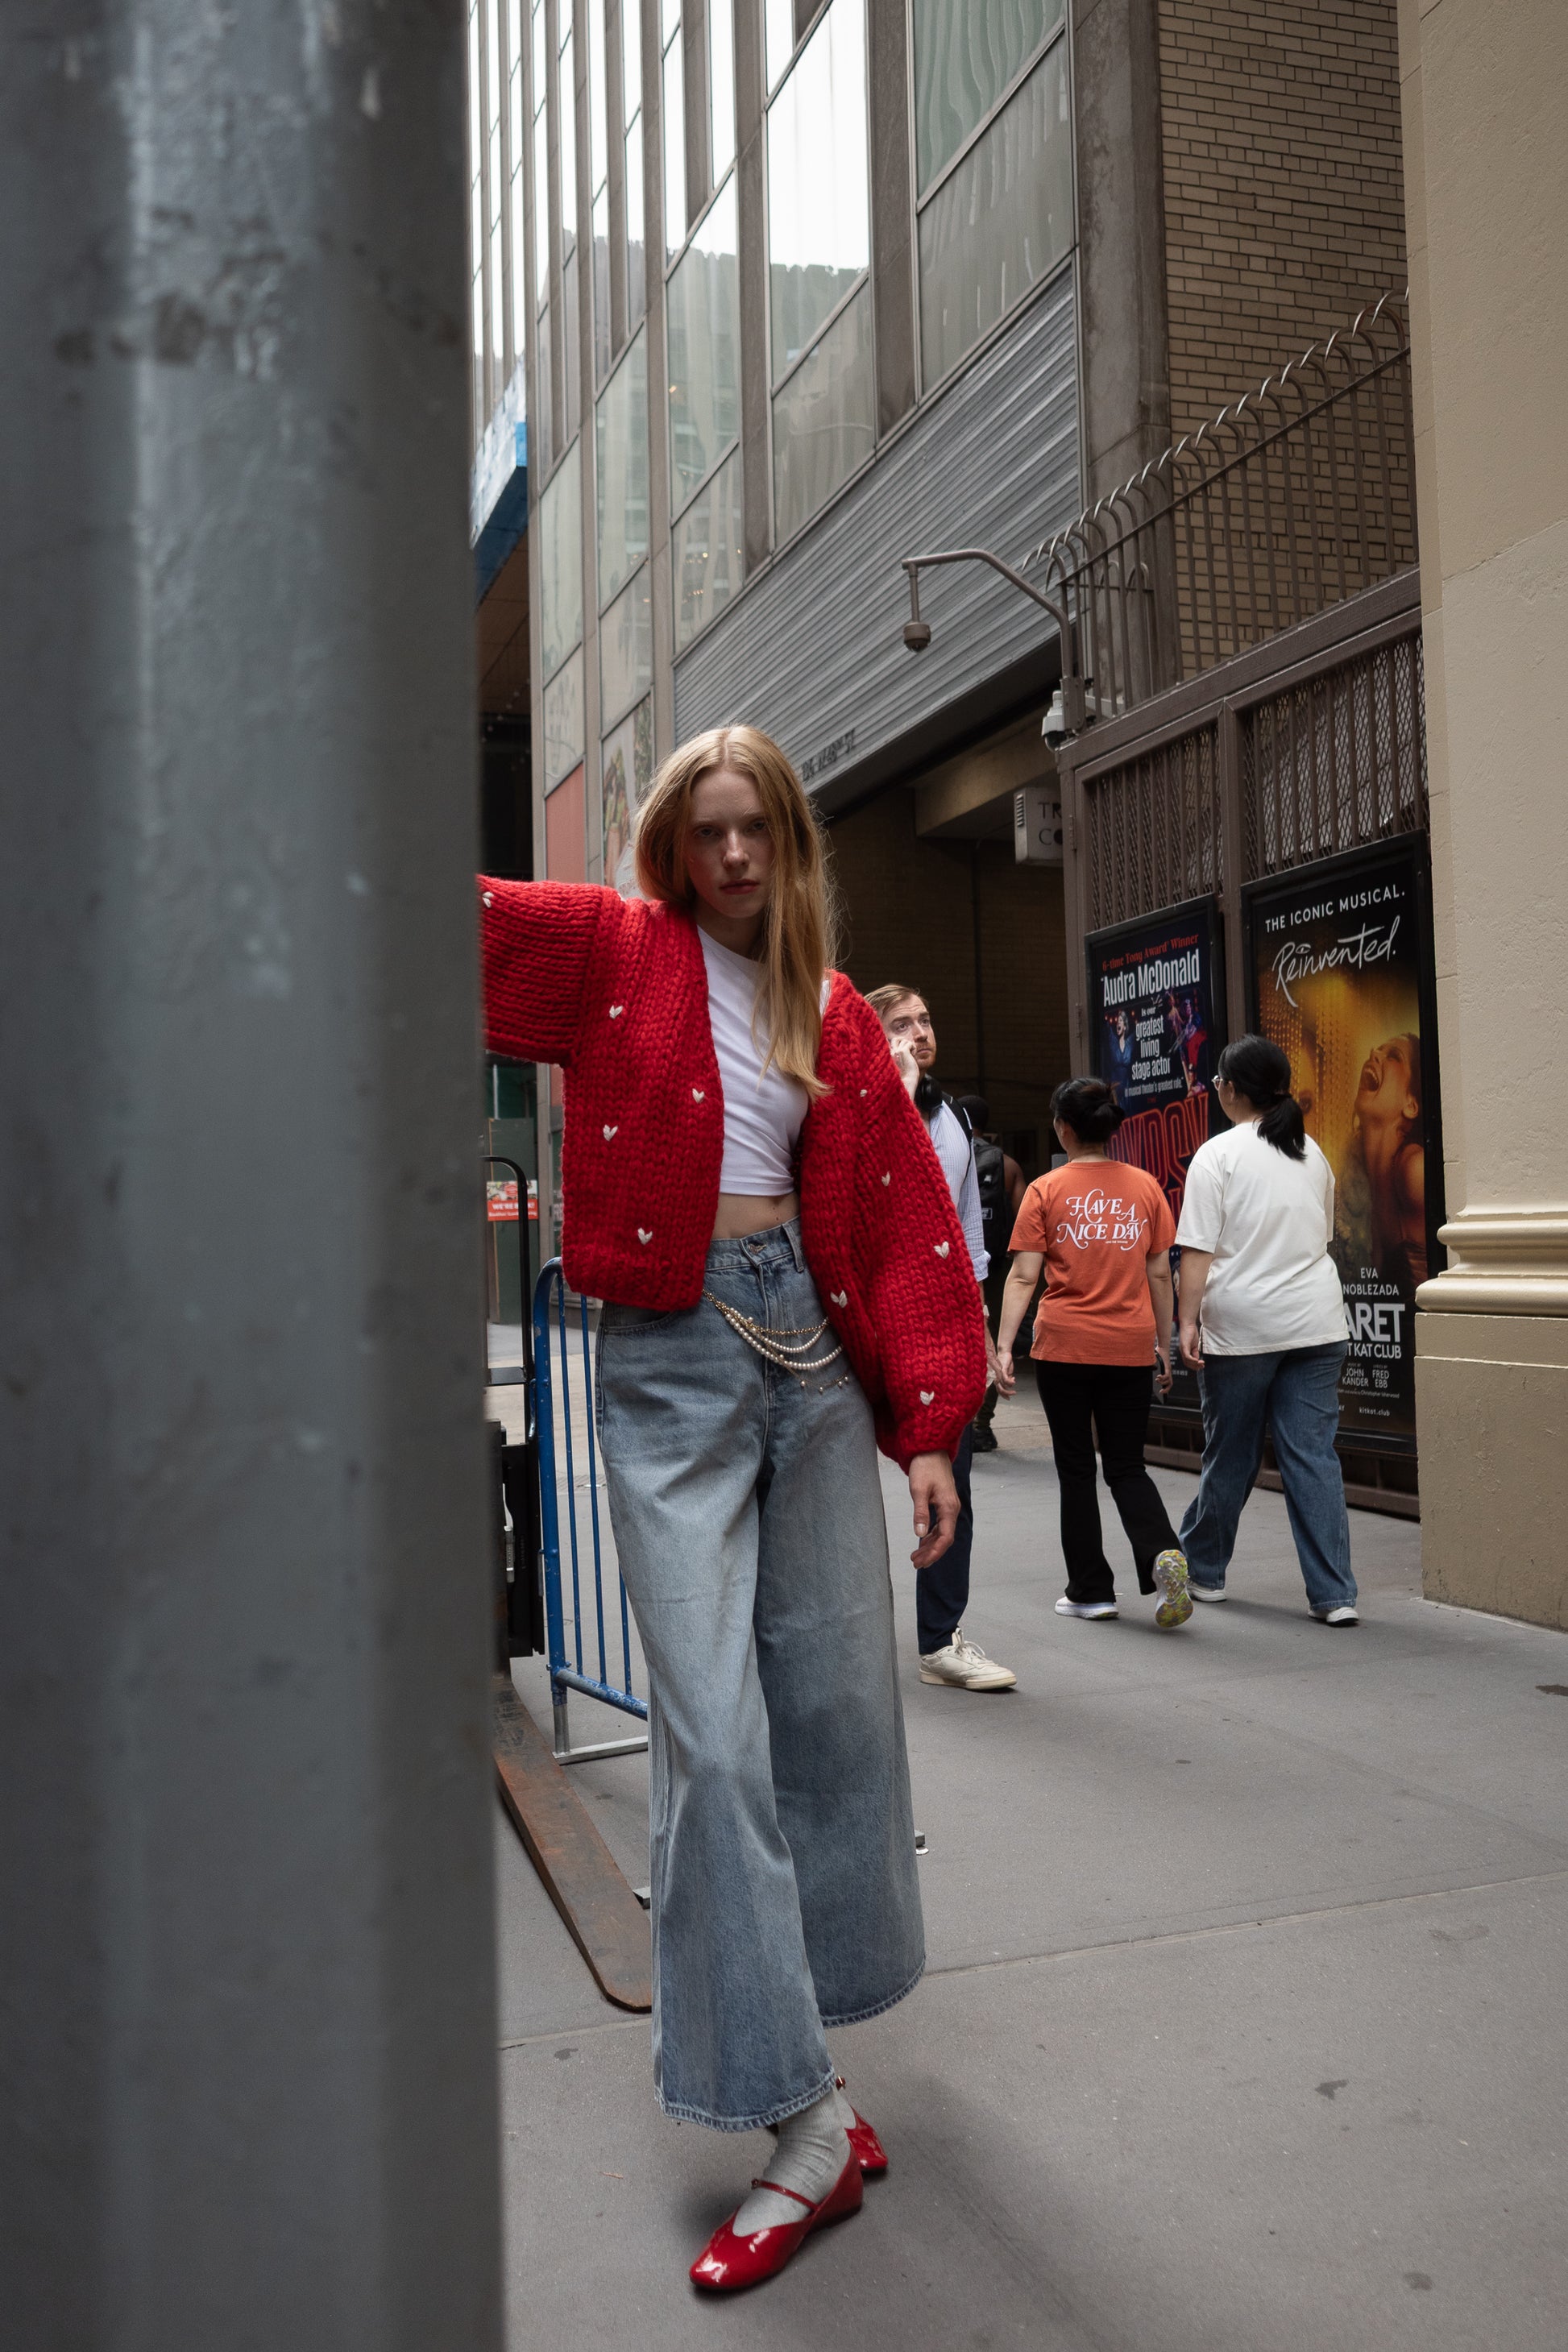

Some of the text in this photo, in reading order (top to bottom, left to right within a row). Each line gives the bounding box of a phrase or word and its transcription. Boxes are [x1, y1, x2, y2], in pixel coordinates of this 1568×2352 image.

[1265, 885, 1405, 933] THE ICONIC MUSICAL.
[1102, 957, 1124, 972] 6-time
[1126, 951, 1143, 965] Tony
[1170, 933, 1199, 949] Winner
[1138, 948, 1200, 997] McDonald
[1135, 1015, 1164, 1039] greatest
[1140, 1039, 1159, 1059] living
[1131, 1058, 1171, 1081] stage actor
[1065, 1188, 1139, 1224] HAVE A
[1056, 1213, 1148, 1251] NICE DAY
[1360, 1267, 1378, 1279] EVA
[1343, 1284, 1399, 1296] NOBLEZADA
[1354, 1343, 1372, 1358] KAT
[1374, 1344, 1402, 1359] CLUB
[1346, 1367, 1364, 1377] JOHN
[1372, 1370, 1390, 1379] FRED
[1342, 1376, 1368, 1387] KANDER
[1375, 1379, 1388, 1388] EBB
[1359, 1407, 1390, 1417] kitkat.club
